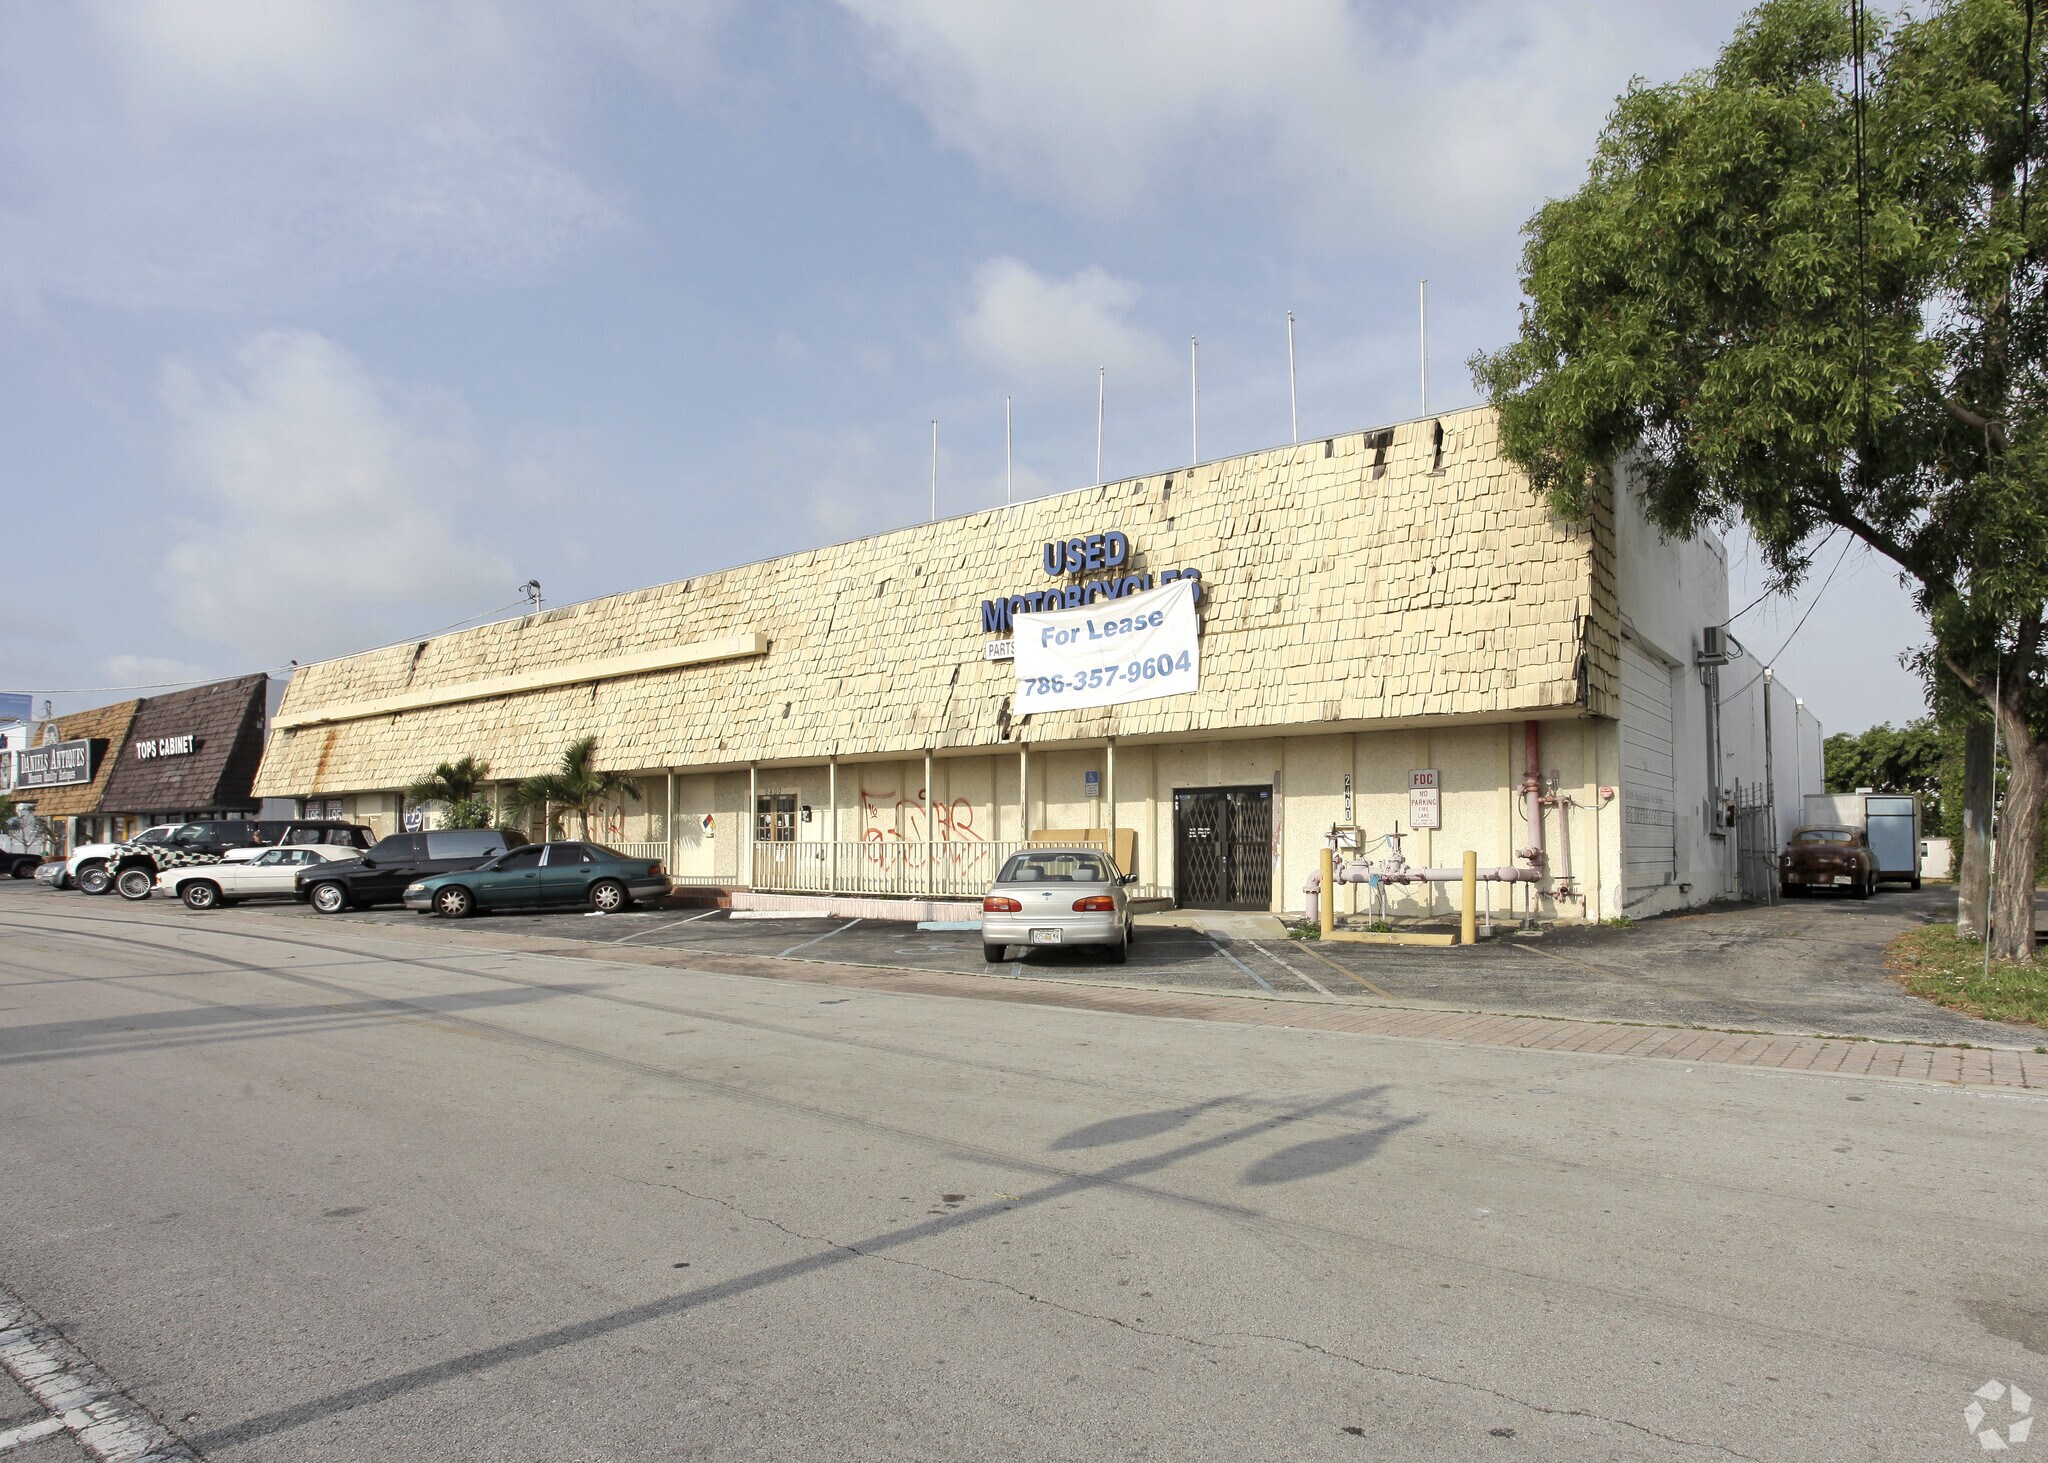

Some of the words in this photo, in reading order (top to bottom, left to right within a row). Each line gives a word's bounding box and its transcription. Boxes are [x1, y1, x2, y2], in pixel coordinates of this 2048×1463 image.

[1044, 530, 1129, 577] USED
[1041, 626, 1080, 648] For
[1086, 610, 1164, 640] Lease
[1025, 650, 1192, 697] 786-357-9604
[51, 747, 85, 770] ANTIQUES
[136, 740, 157, 759] TOPS
[159, 734, 194, 757] CABINET
[1413, 773, 1433, 785] FDC
[1411, 798, 1437, 806] PARKING
